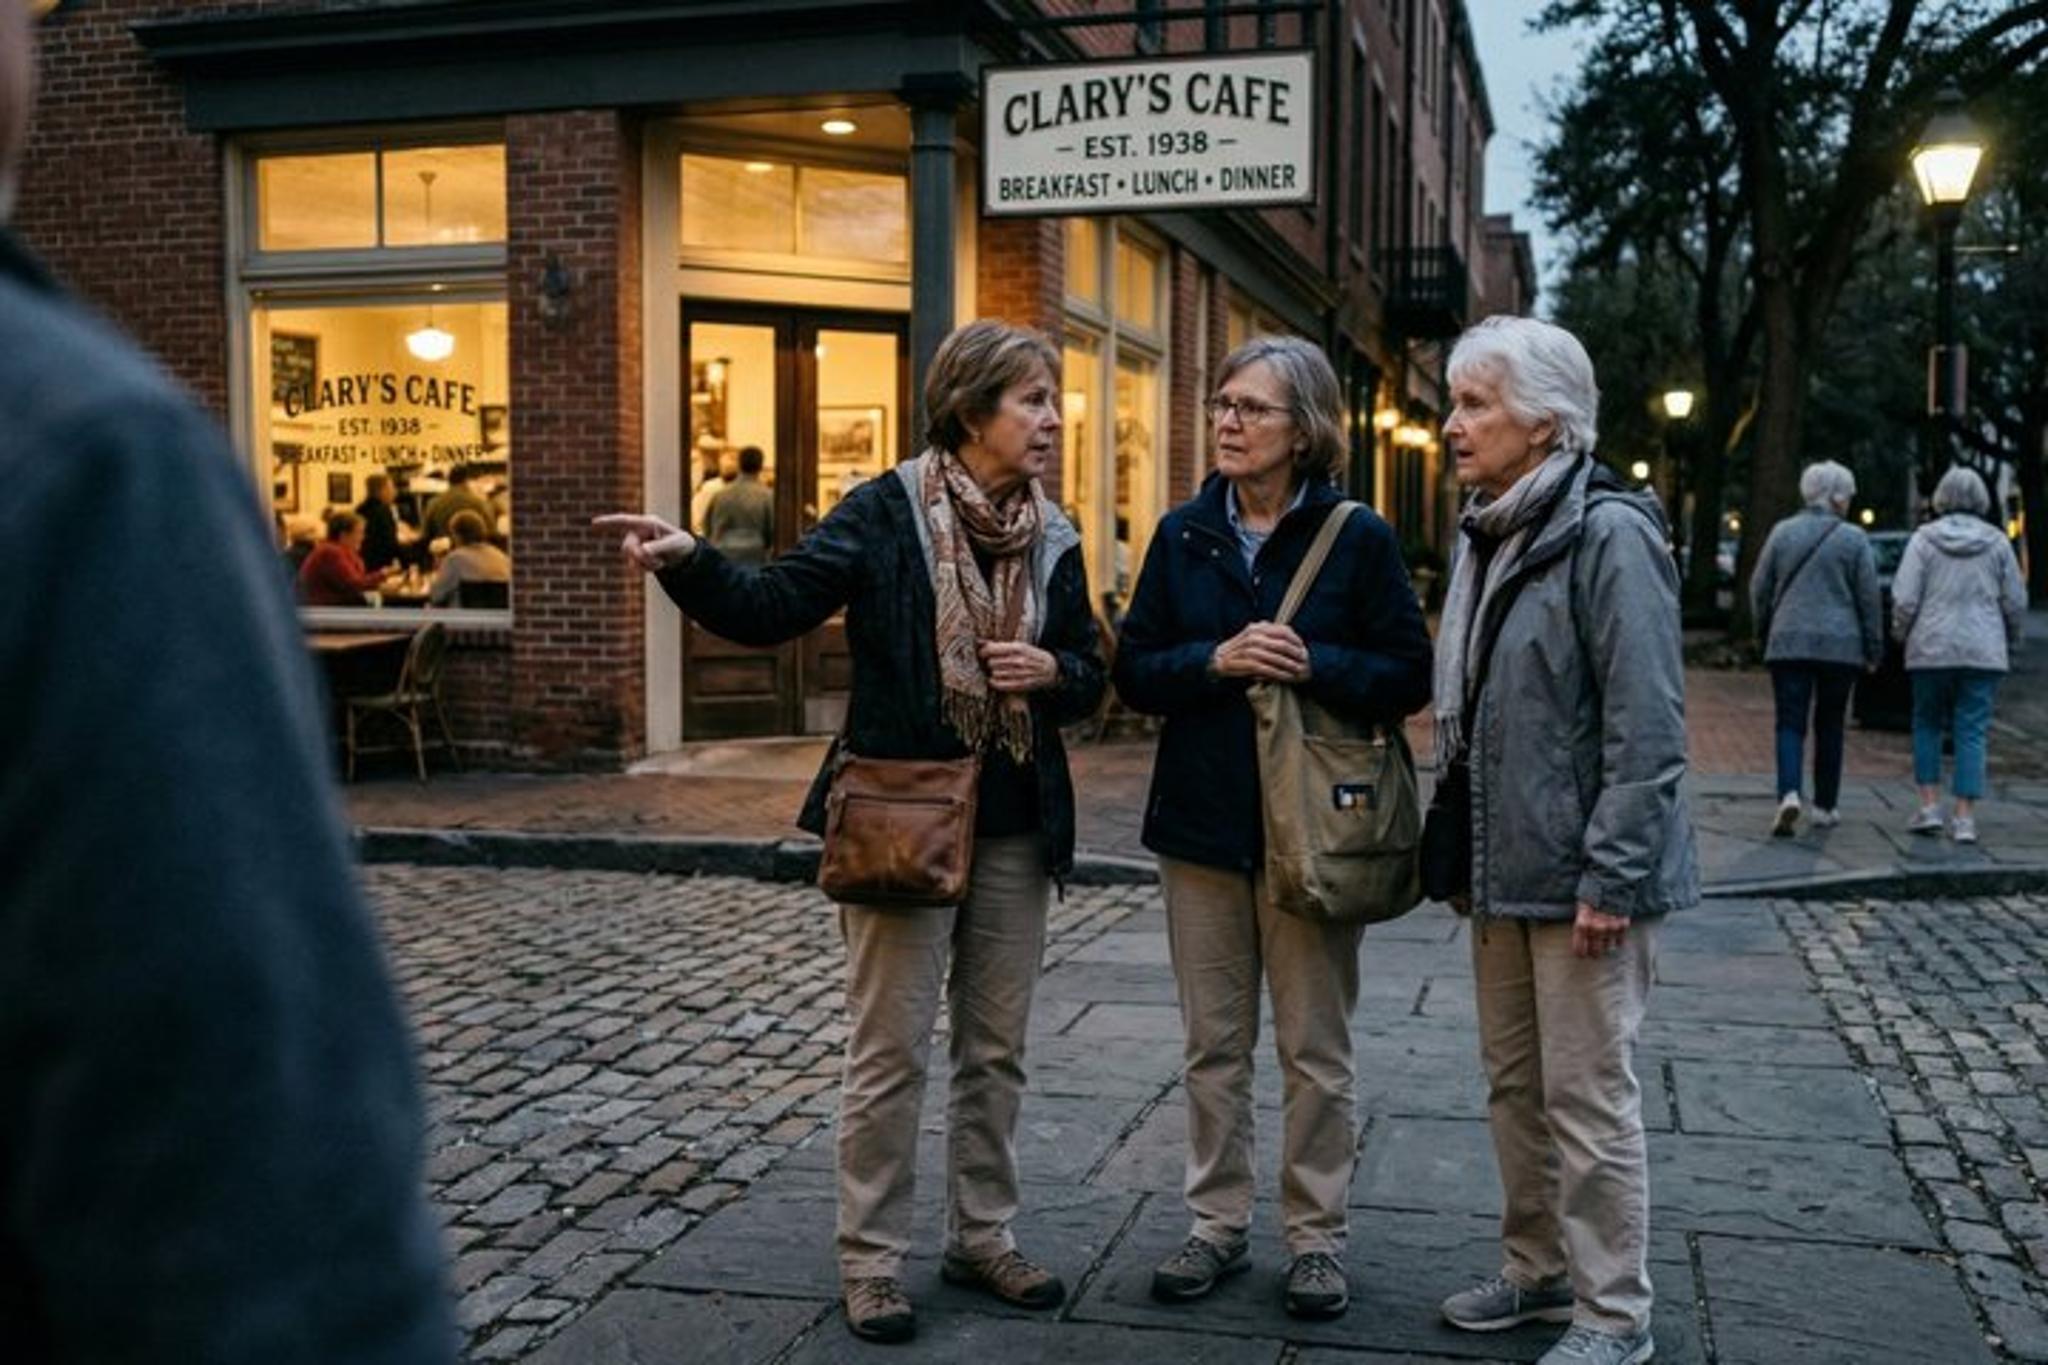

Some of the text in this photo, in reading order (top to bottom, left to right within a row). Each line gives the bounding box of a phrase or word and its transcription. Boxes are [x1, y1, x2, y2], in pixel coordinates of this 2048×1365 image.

[1003, 73, 1290, 136] CLARY'S CAFE
[1084, 131, 1208, 158] EST. 1938
[1001, 165, 1296, 200] BREAKFAST LUNCH DINNER
[284, 374, 476, 418] CLARY'S CAFE
[338, 418, 421, 436] EST. 1938
